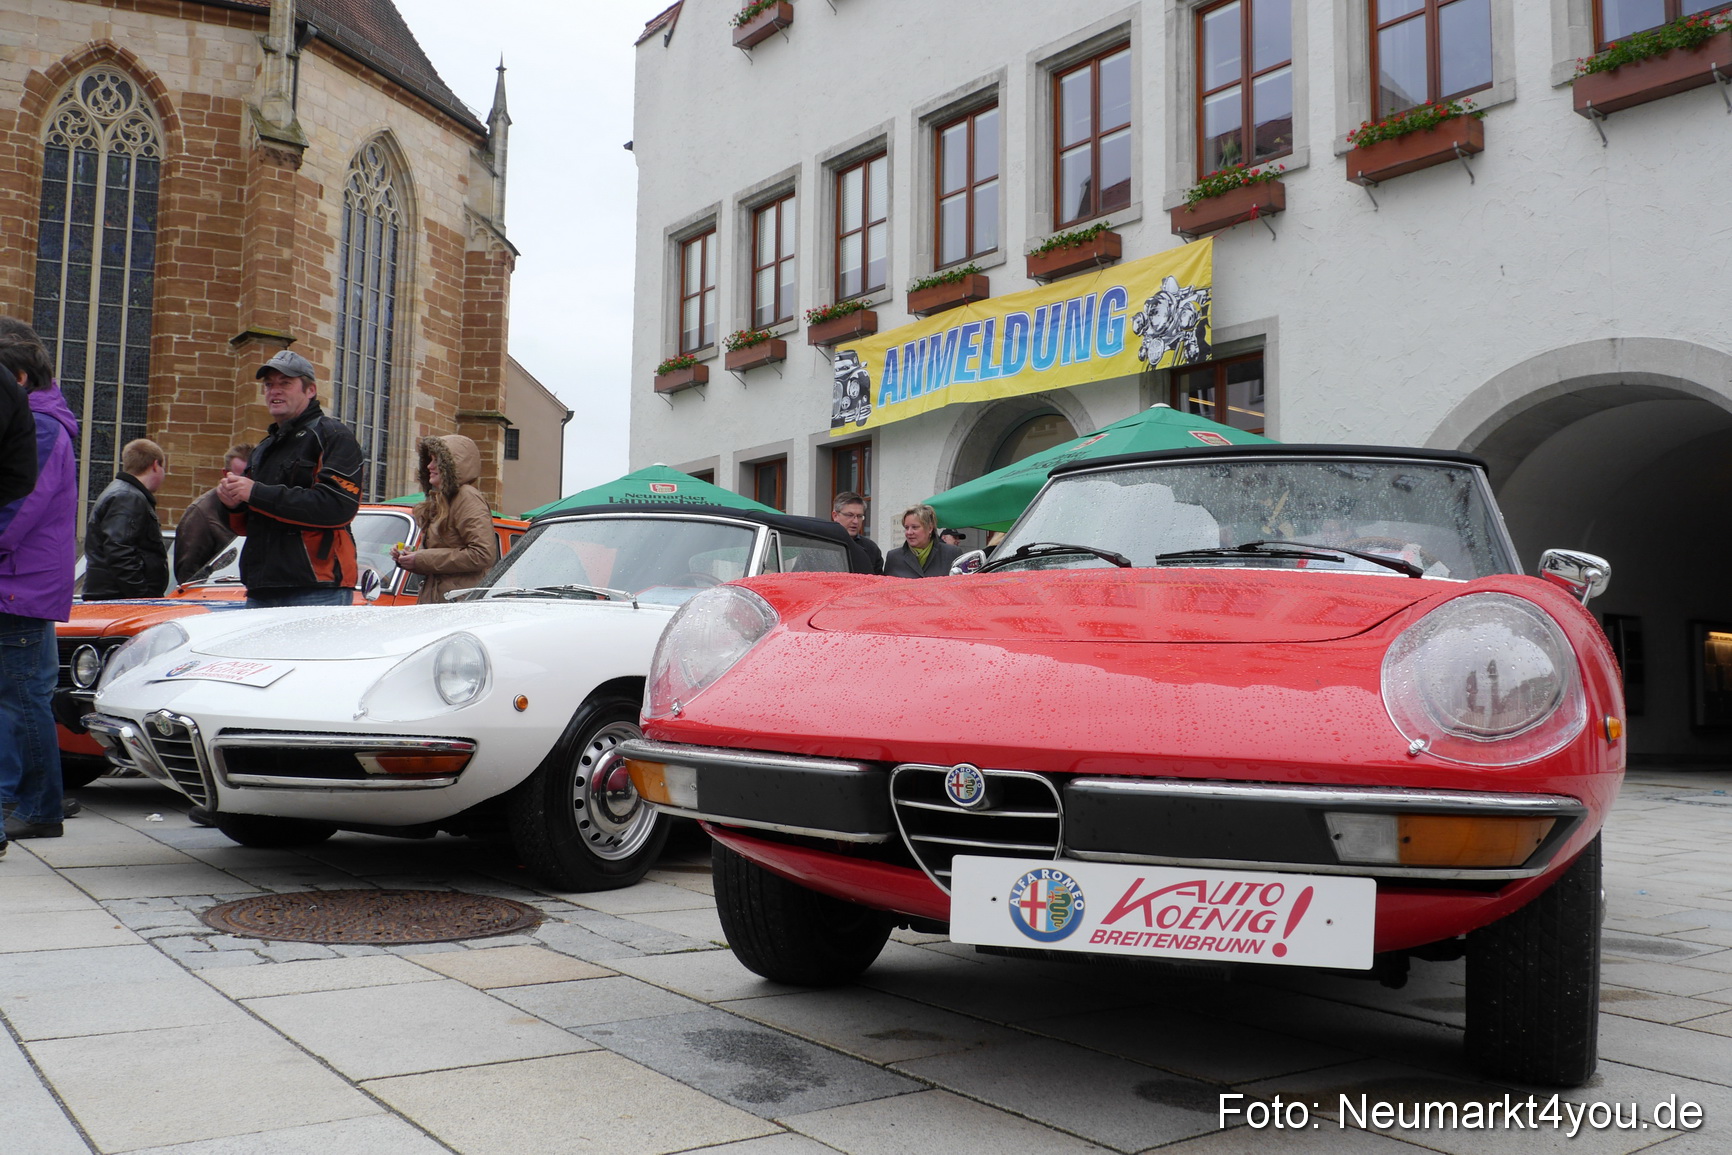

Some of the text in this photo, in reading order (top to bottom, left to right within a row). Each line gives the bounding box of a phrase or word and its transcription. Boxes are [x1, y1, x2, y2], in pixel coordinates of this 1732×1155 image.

[877, 285, 1128, 408] ANMELDUNG
[330, 475, 360, 495] KTM
[624, 493, 706, 501] Neumarkter
[1010, 868, 1085, 911] ALFA ROMEO
[1173, 879, 1285, 907] AUTO
[1088, 929, 1265, 955] BREITENBRUNN
